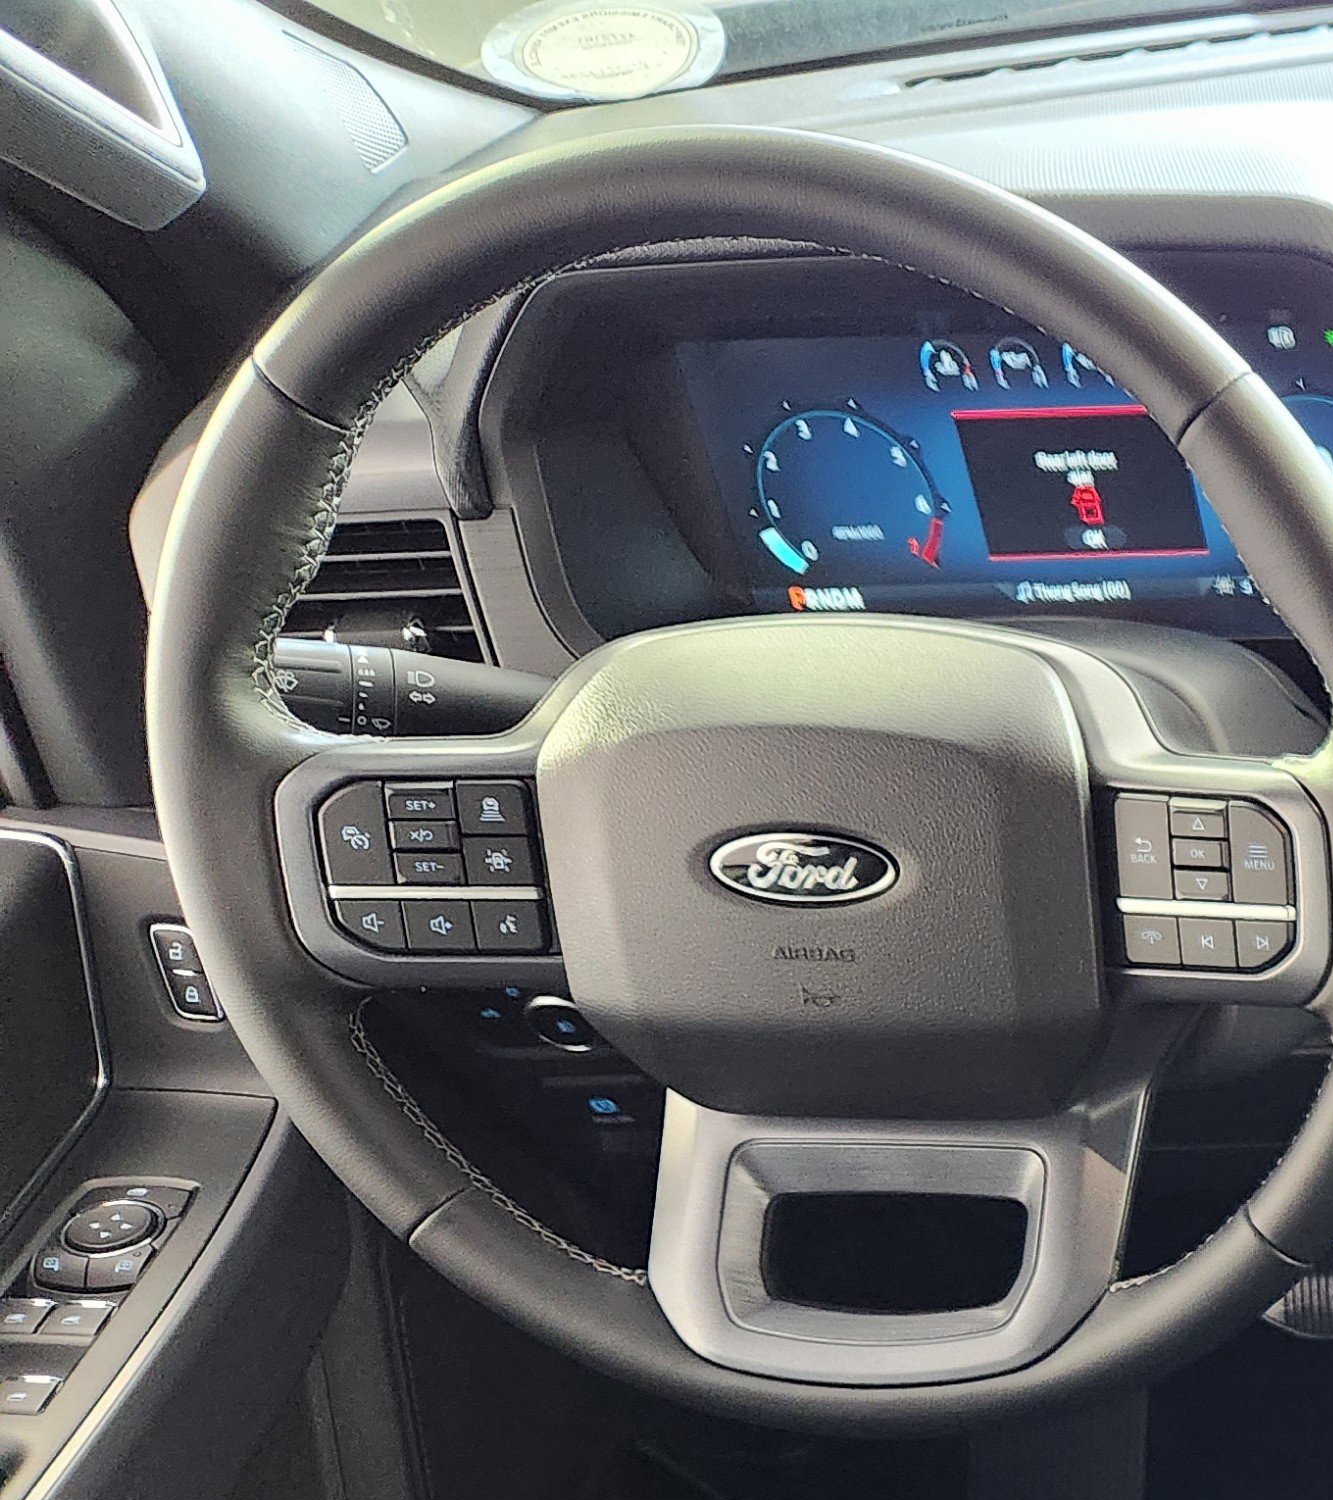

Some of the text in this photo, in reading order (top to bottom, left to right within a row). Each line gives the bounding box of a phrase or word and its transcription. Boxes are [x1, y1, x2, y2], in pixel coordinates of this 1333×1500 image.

[801, 540, 818, 561] 0
[1130, 852, 1157, 864] BACK
[1190, 849, 1206, 860] OK
[747, 841, 858, 890] Ford
[1244, 859, 1275, 871] MENU
